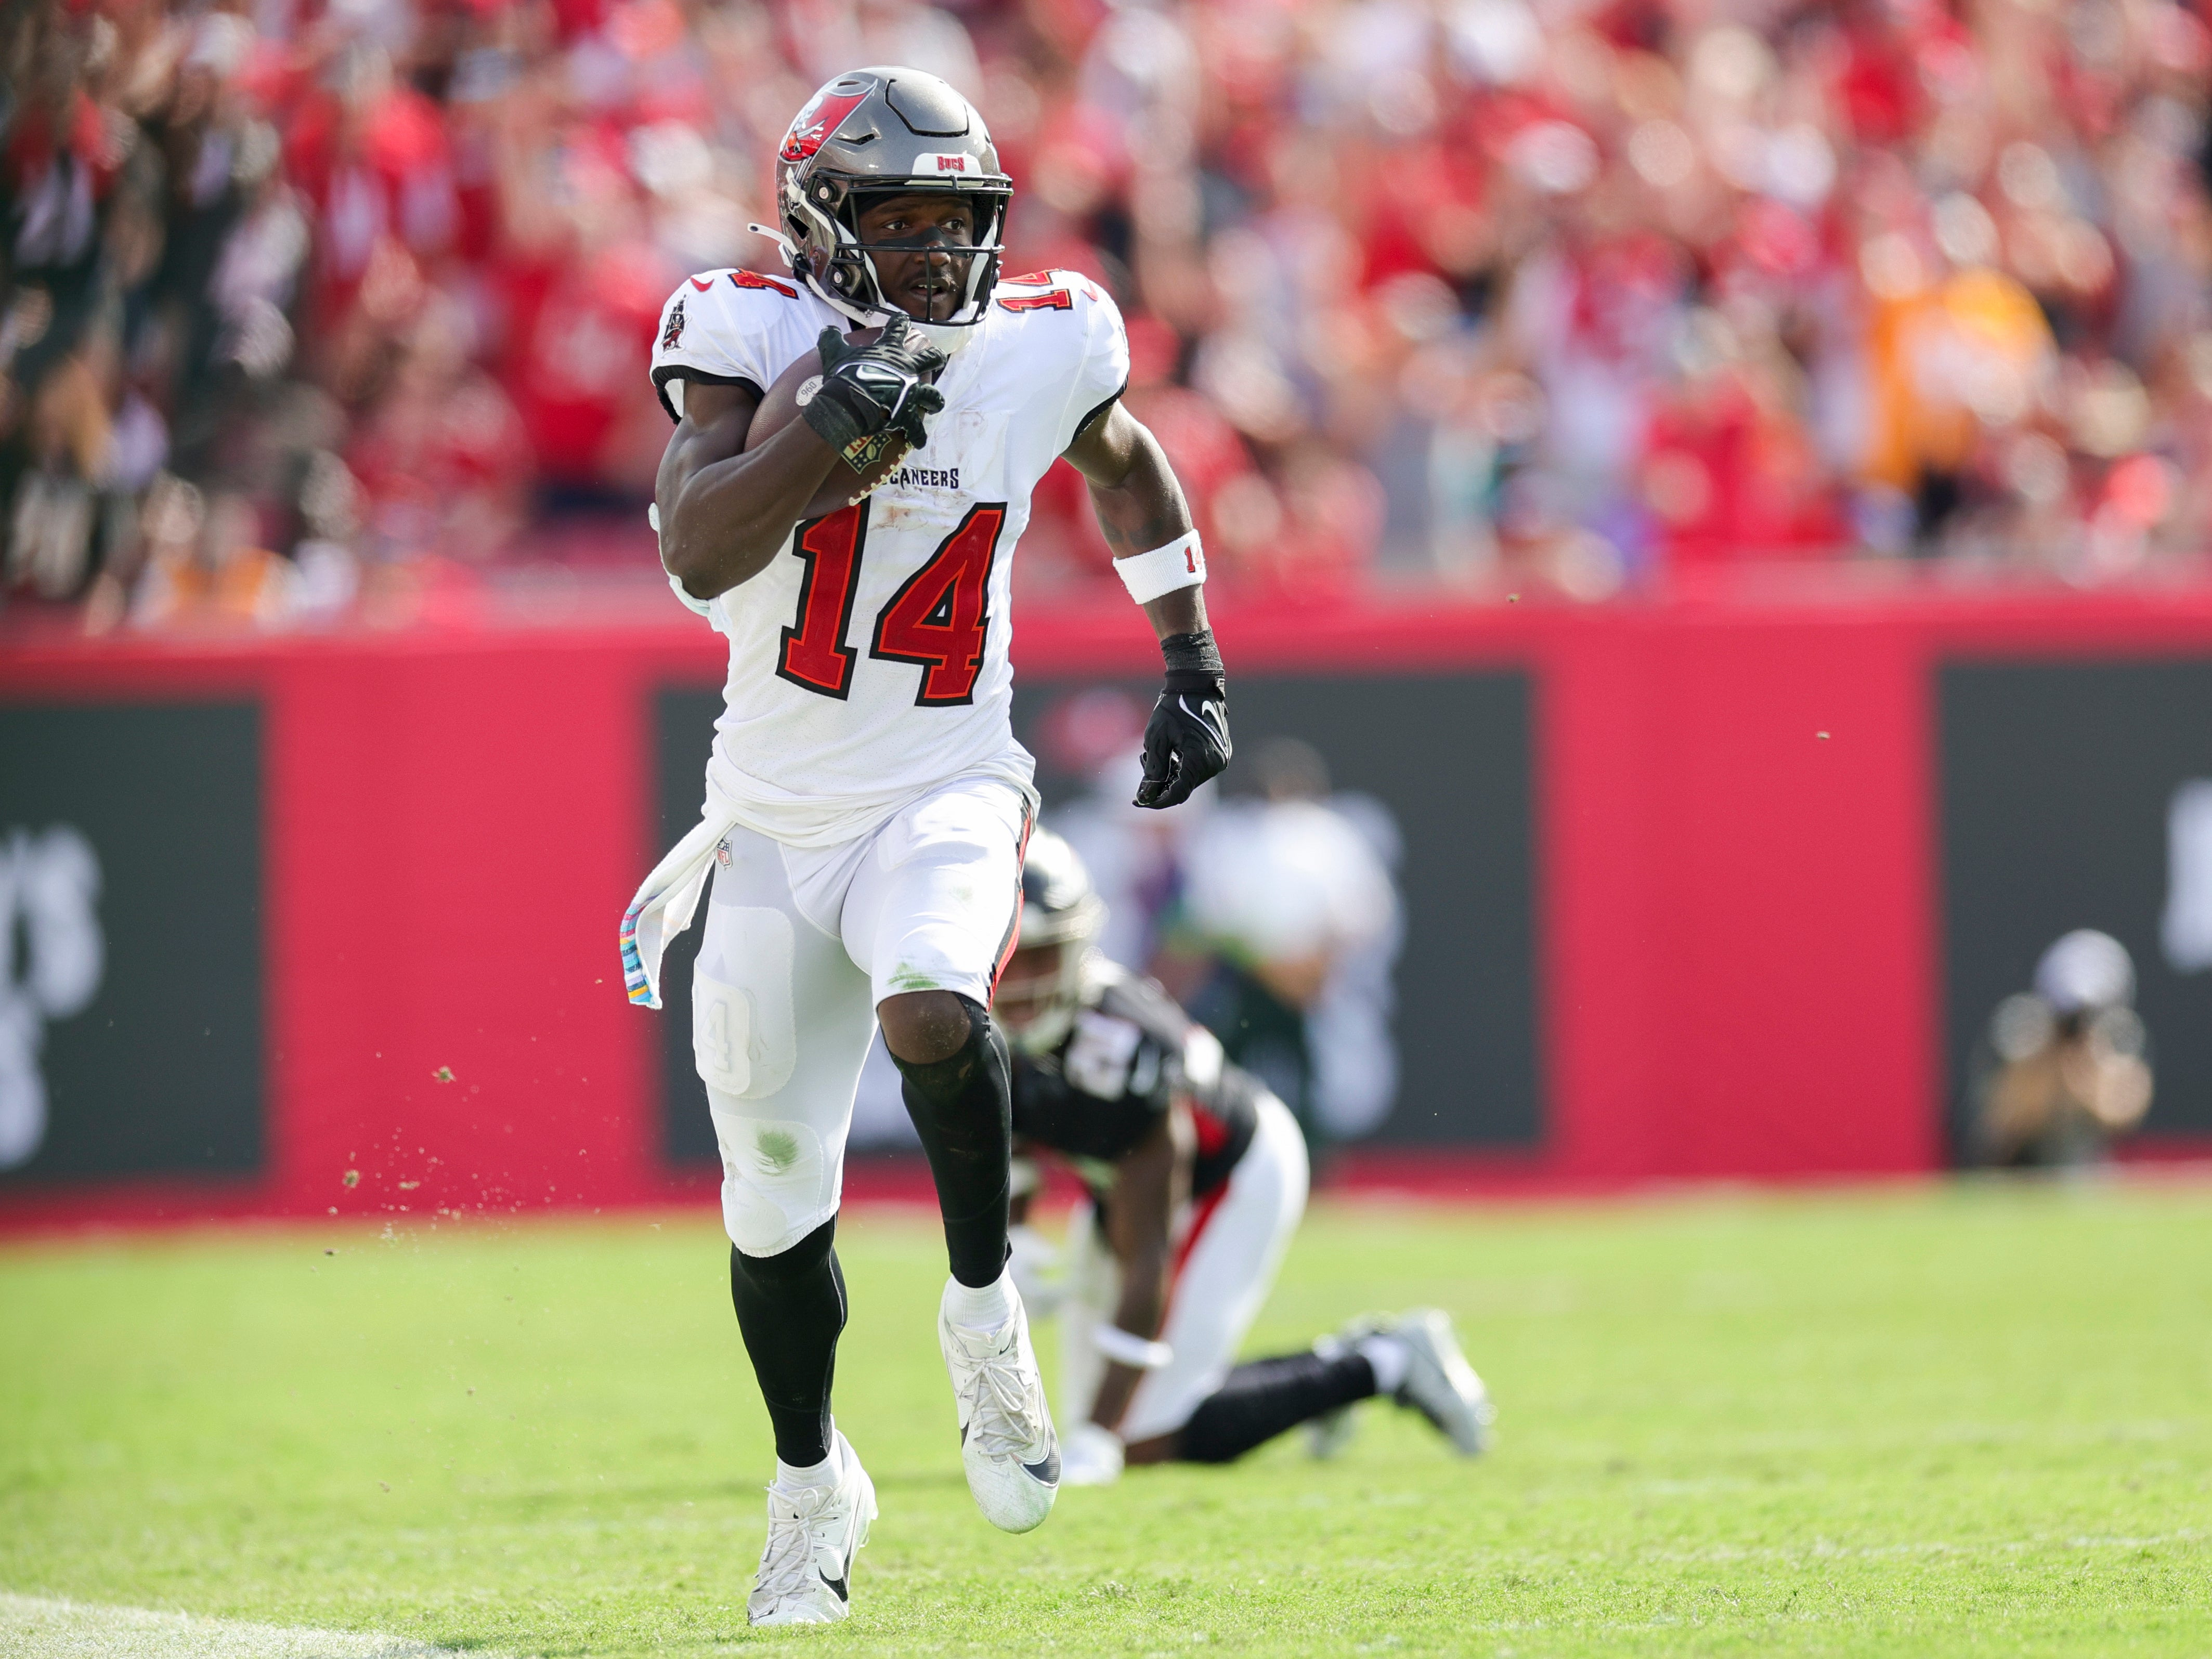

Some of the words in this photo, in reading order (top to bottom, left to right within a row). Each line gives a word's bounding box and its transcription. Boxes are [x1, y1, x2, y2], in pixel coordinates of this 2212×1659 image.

[937, 156, 965, 172] BUCS
[882, 468, 958, 490] CANEERS
[775, 495, 1008, 707] 14
